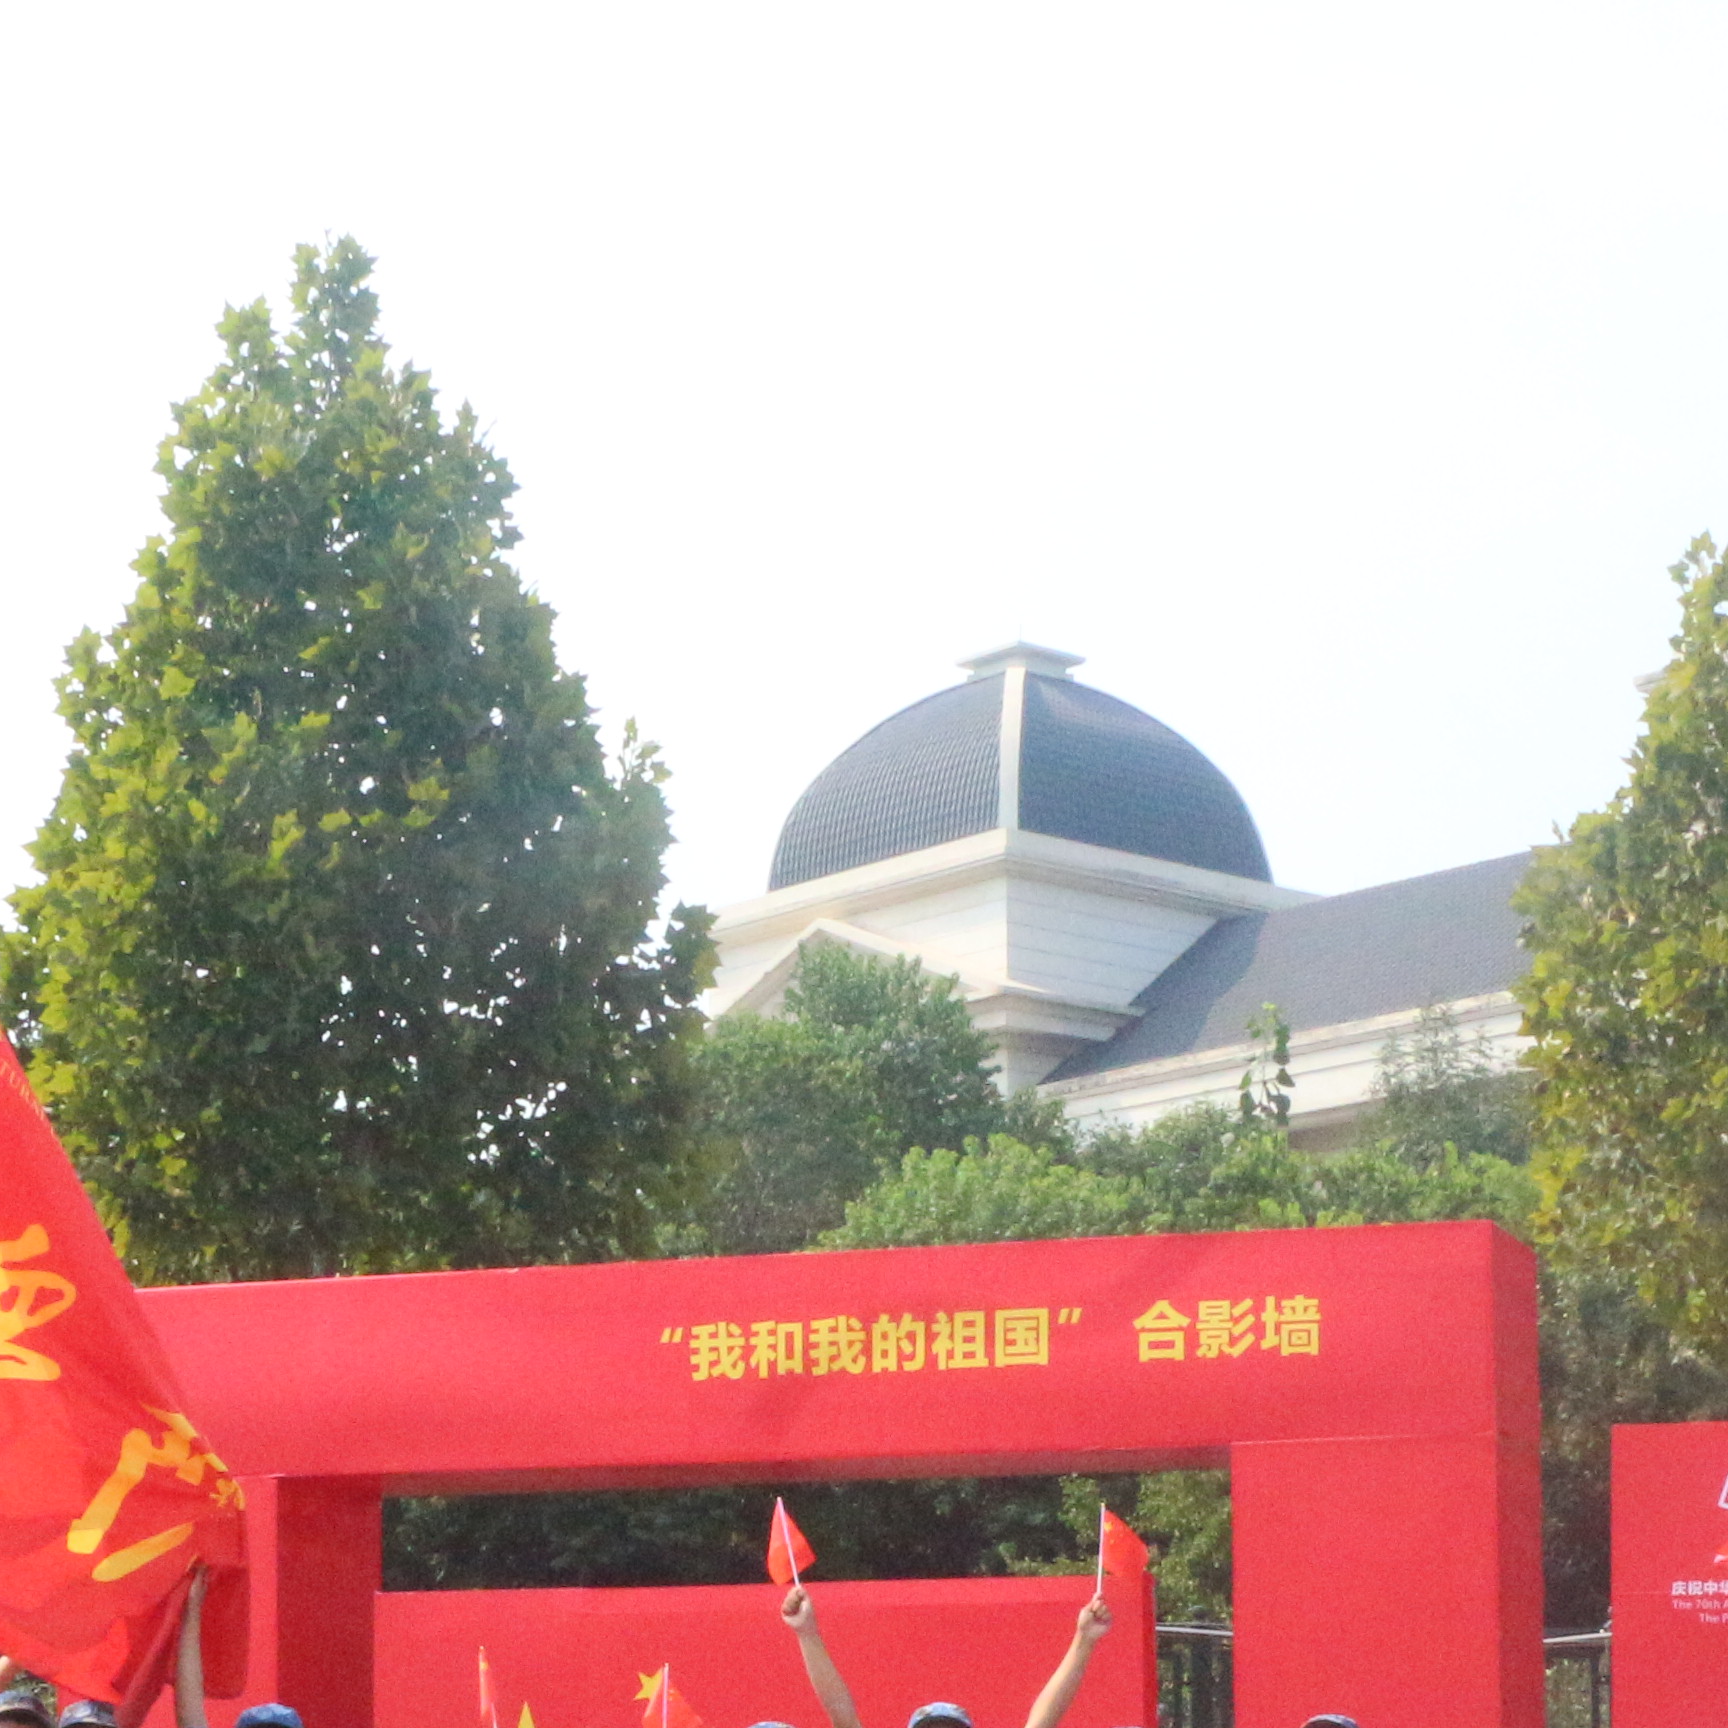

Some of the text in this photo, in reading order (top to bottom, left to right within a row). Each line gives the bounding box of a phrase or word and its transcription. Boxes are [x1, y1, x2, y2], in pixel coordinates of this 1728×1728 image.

[659, 1294, 1322, 1382] “我和我的祖国” 合影墙
